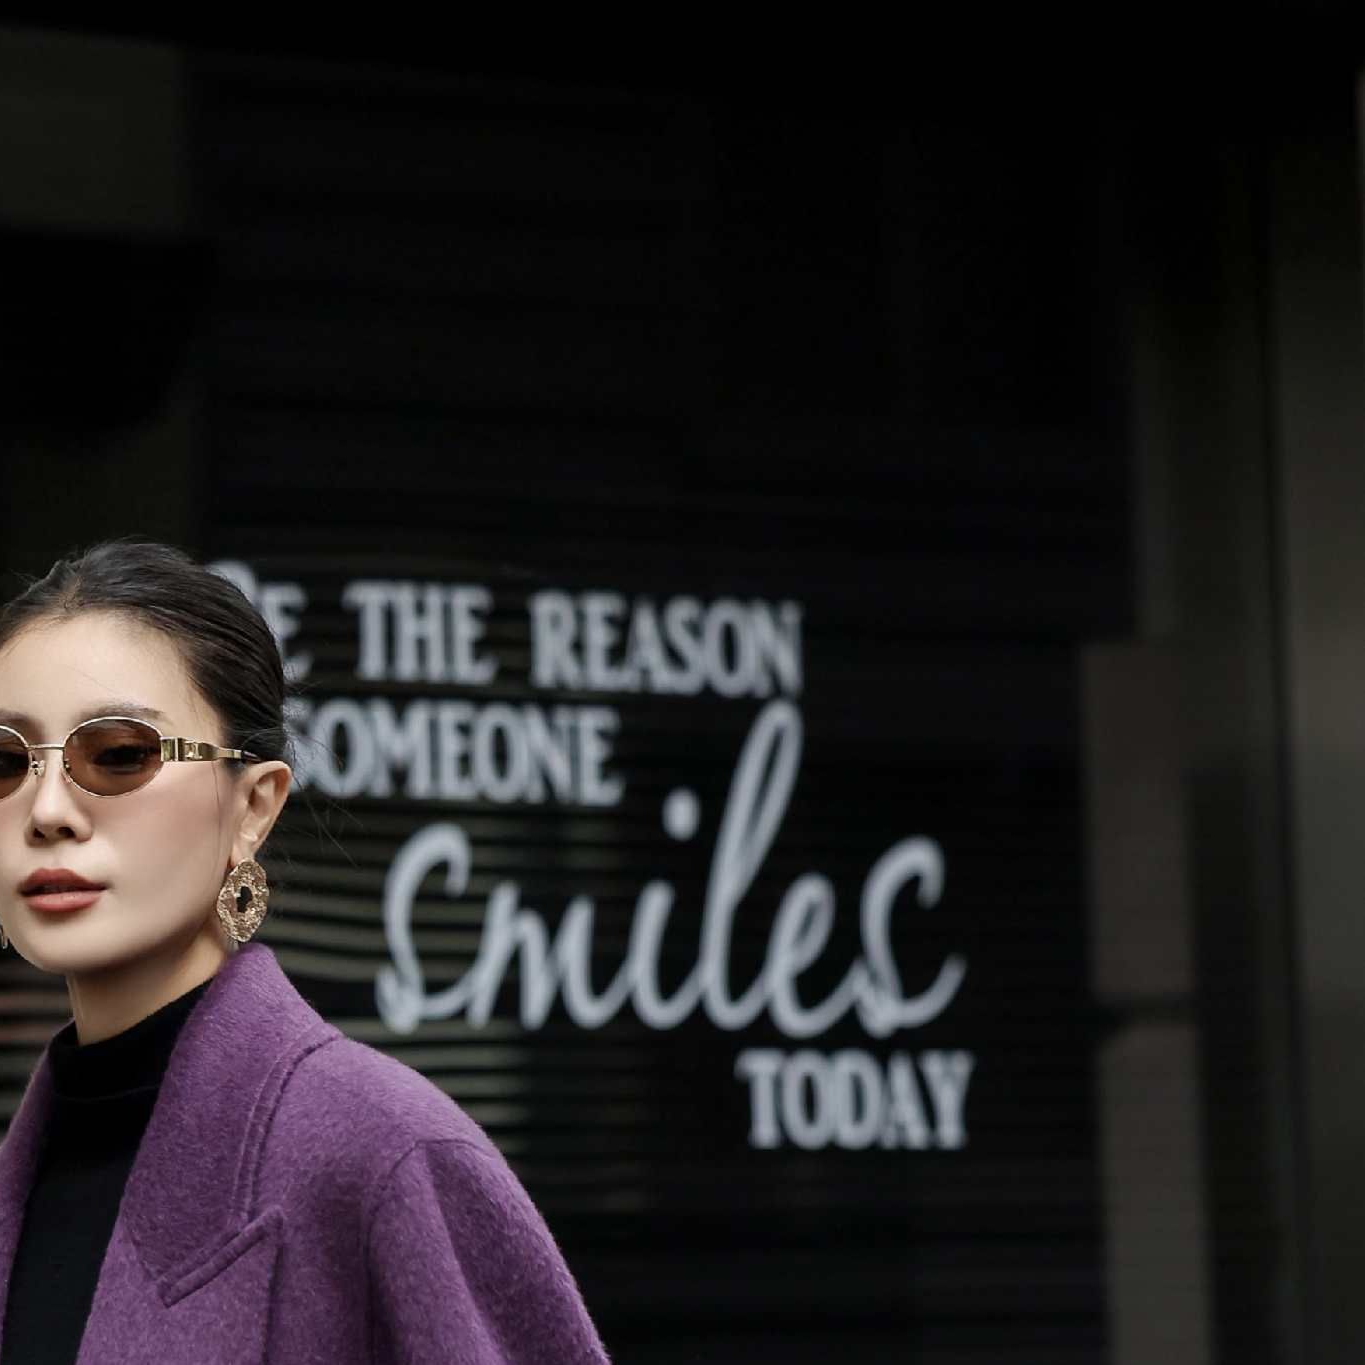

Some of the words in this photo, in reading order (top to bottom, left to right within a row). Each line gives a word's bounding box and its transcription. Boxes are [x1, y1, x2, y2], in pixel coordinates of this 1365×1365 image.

[207, 562, 312, 682] E
[344, 580, 497, 685] THE
[531, 591, 801, 696] REASON
[738, 1050, 971, 1149] TODAY
